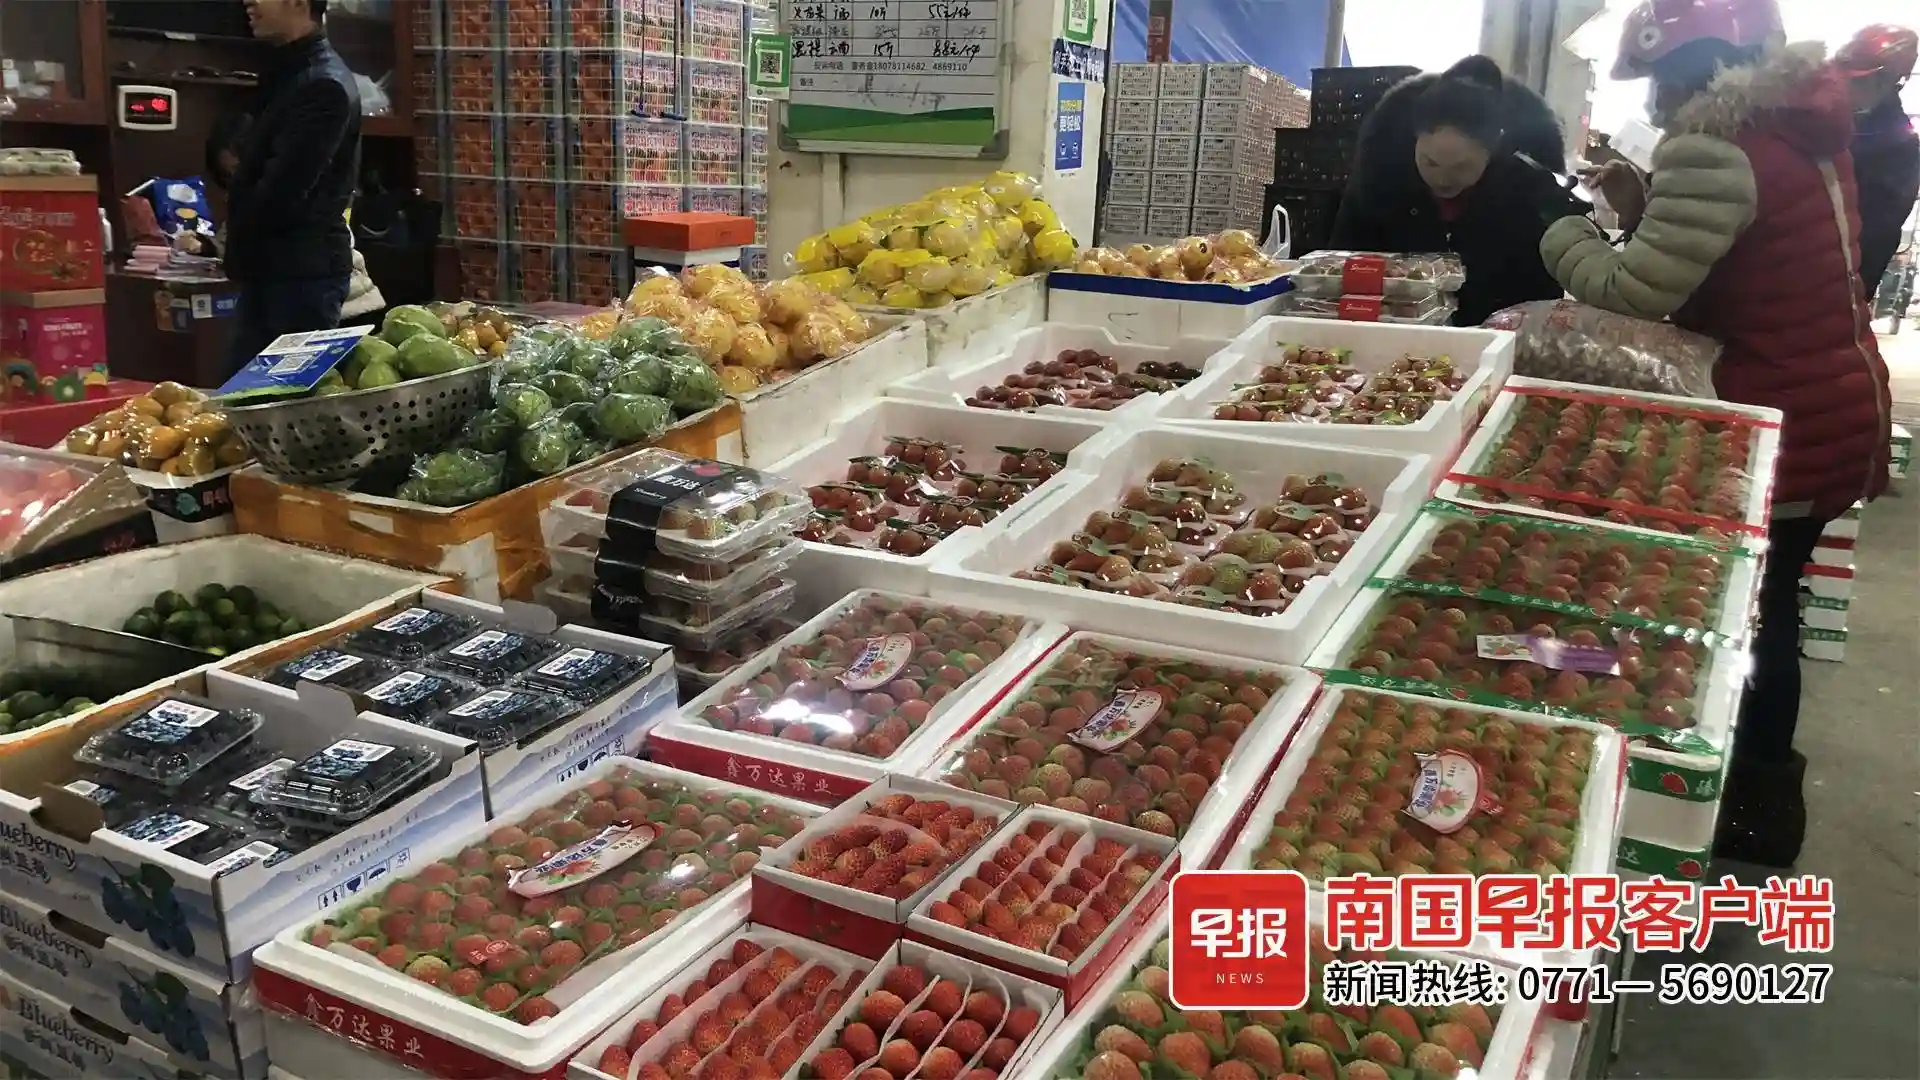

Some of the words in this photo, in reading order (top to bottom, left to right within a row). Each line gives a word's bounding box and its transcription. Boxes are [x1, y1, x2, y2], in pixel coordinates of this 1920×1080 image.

[725, 754, 832, 795] 鑫万达果业
[0, 904, 93, 968] Blueberry
[17, 997, 114, 1064] Blueberry
[303, 993, 425, 1059] 鑫万达果业
